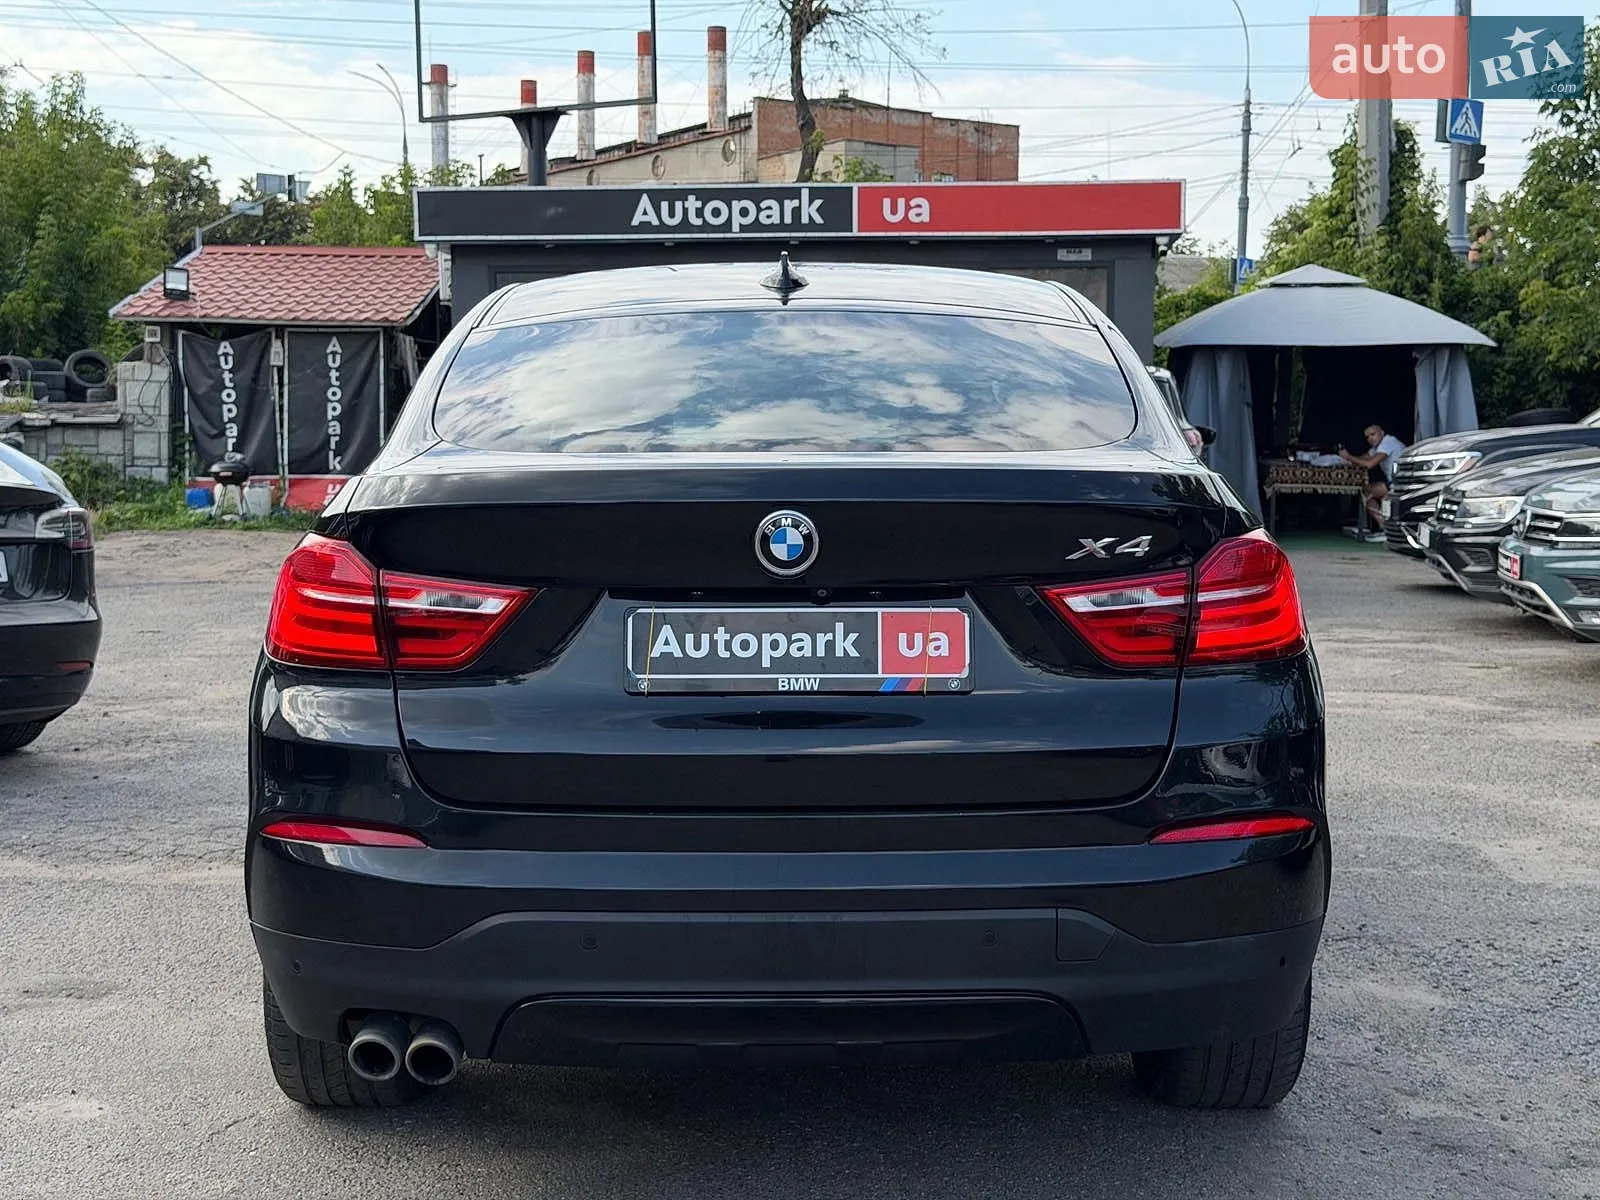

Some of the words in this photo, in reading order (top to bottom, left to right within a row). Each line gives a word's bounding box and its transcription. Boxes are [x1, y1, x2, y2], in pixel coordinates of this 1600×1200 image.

[630, 187, 824, 234] Autopark
[882, 195, 931, 225] ua
[217, 340, 238, 462] Autopar
[326, 335, 343, 471] Autopark
[764, 517, 810, 537] BMW
[1065, 535, 1153, 560] X4
[650, 622, 860, 668] Autopark
[898, 631, 949, 658] ua
[778, 678, 820, 692] BMW
